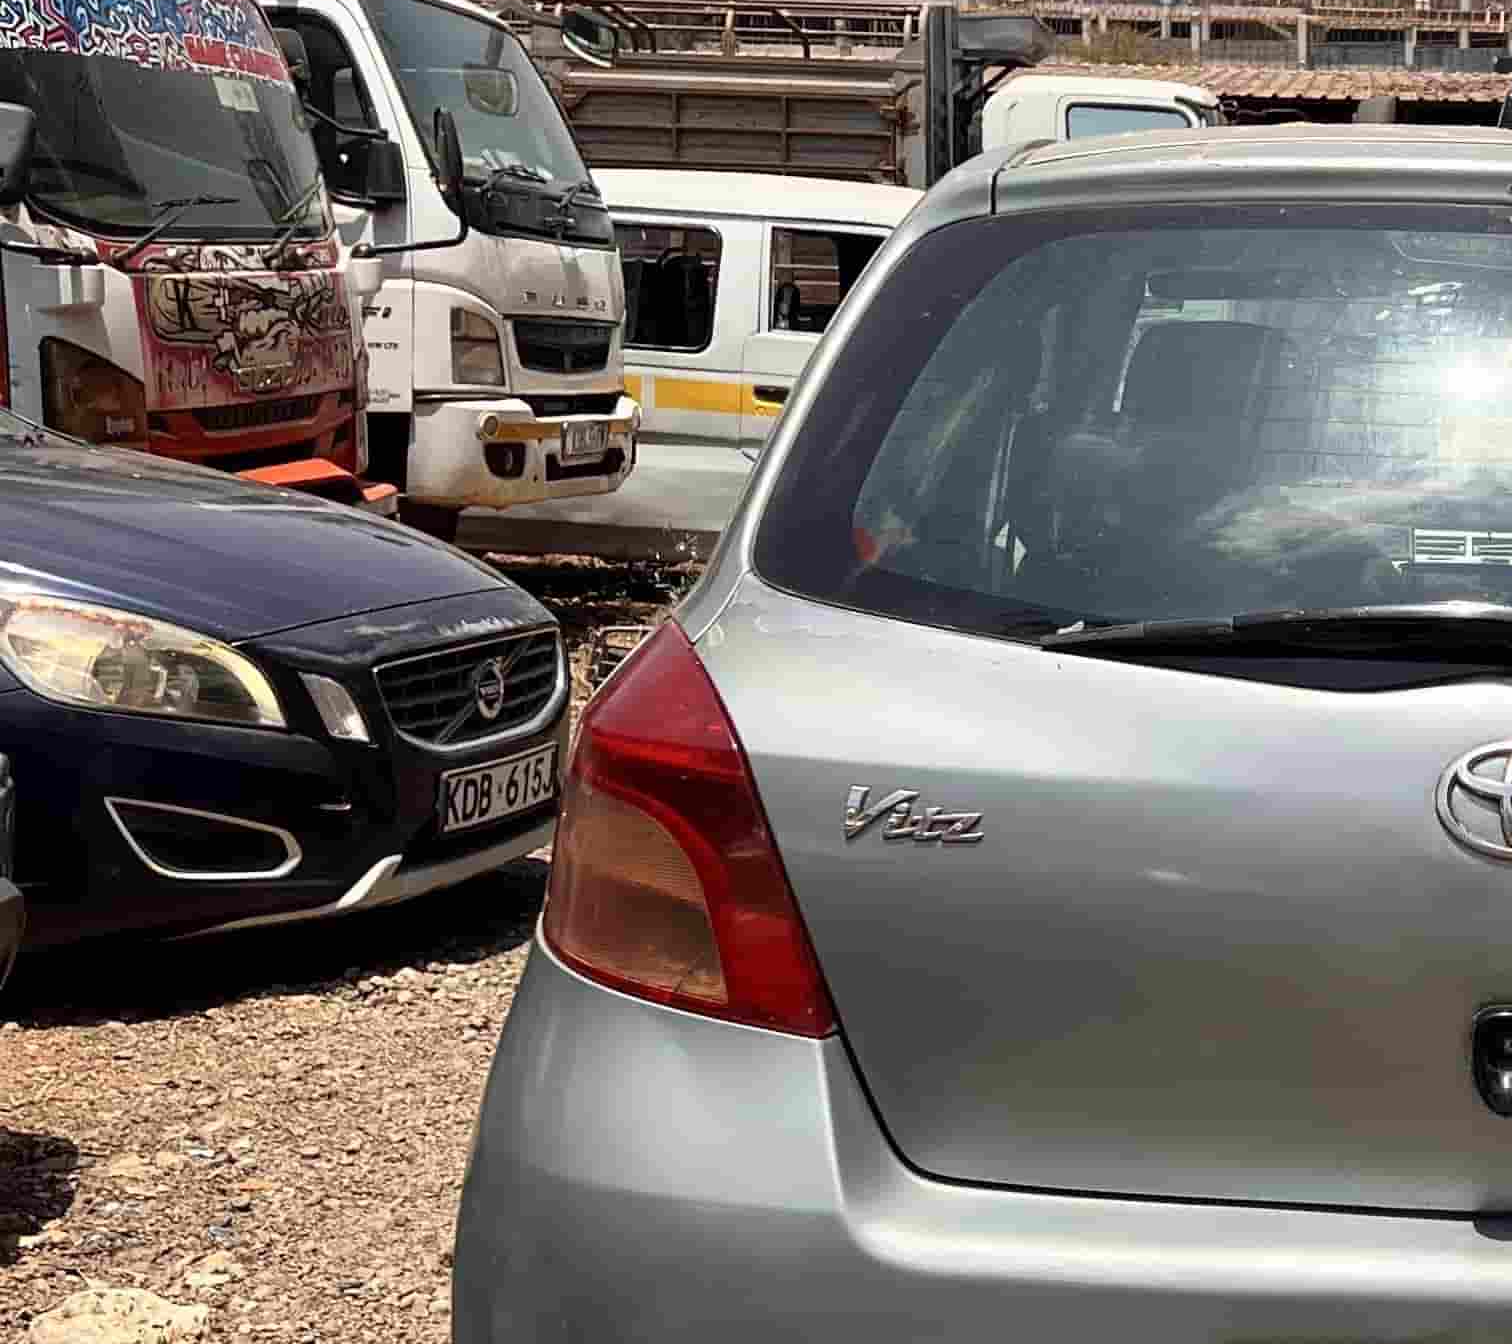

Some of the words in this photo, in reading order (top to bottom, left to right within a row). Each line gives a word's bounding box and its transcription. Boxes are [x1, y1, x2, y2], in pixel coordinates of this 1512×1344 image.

[449, 773, 493, 823] KDB
[506, 756, 557, 807] 615J
[845, 785, 985, 842] Vitz
